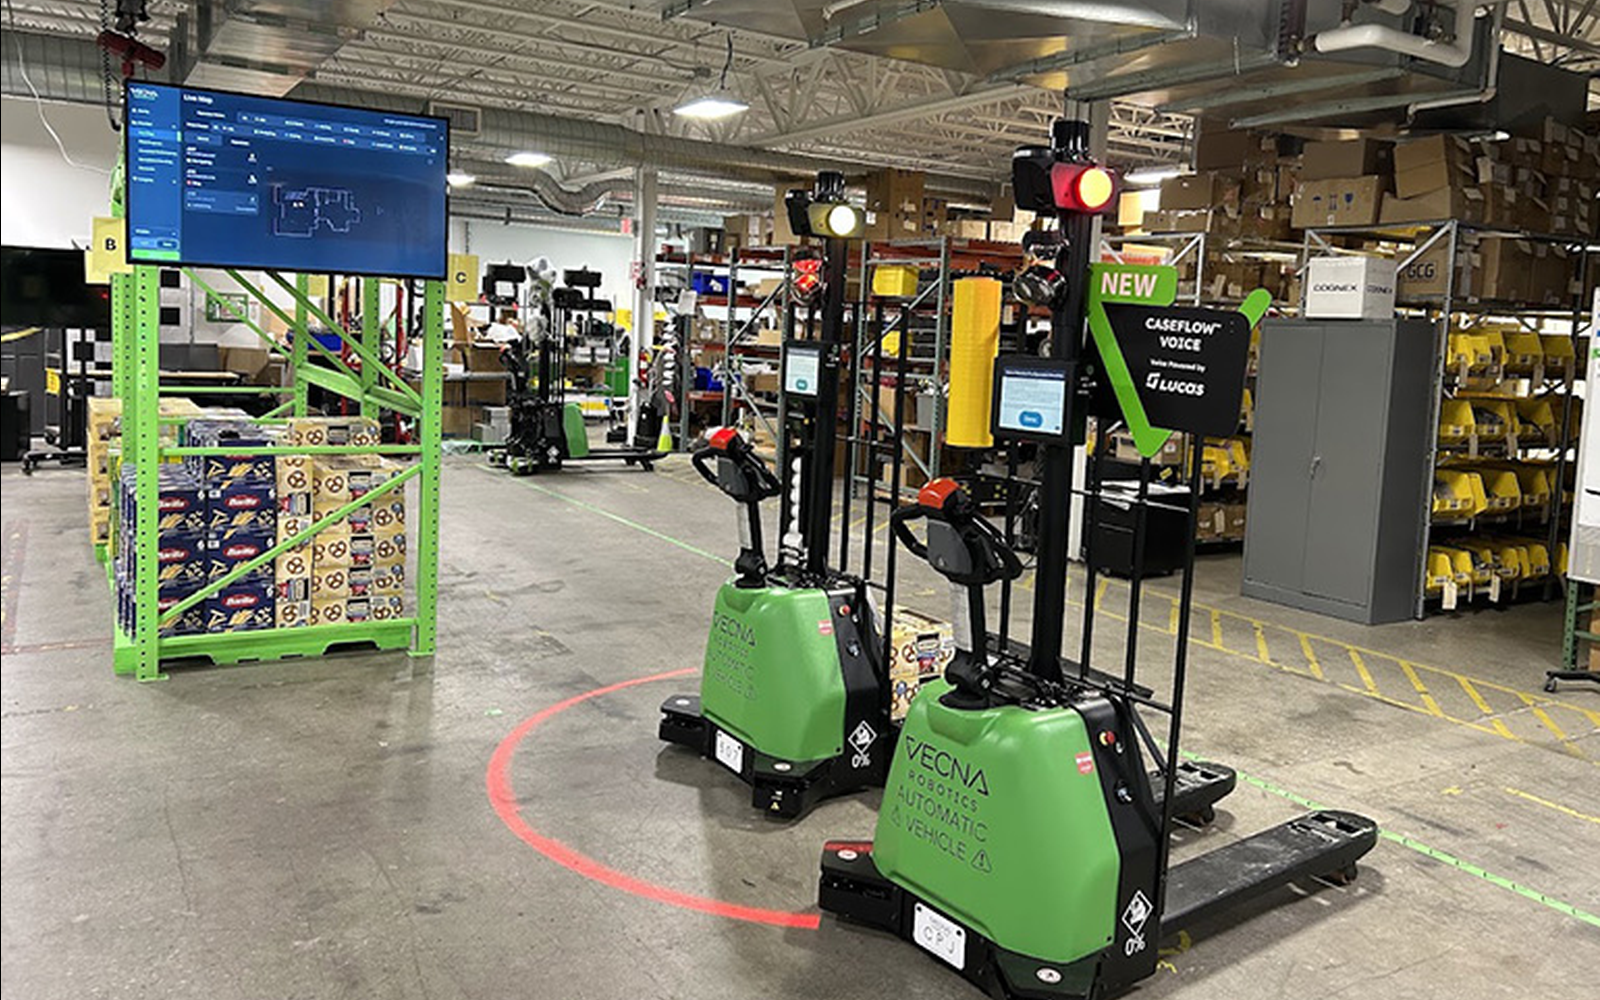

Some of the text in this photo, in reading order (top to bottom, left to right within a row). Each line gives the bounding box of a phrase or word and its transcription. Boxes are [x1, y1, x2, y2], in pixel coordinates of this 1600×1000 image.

[105, 238, 116, 250] B
[456, 271, 467, 284] C
[1101, 272, 1158, 298] NEW
[1160, 336, 1202, 351] VOICE
[905, 735, 989, 796] VECNA
[908, 770, 978, 813] ROBOTICS
[898, 785, 988, 843] AUTOMATIC
[906, 814, 966, 862] VEHICLE
